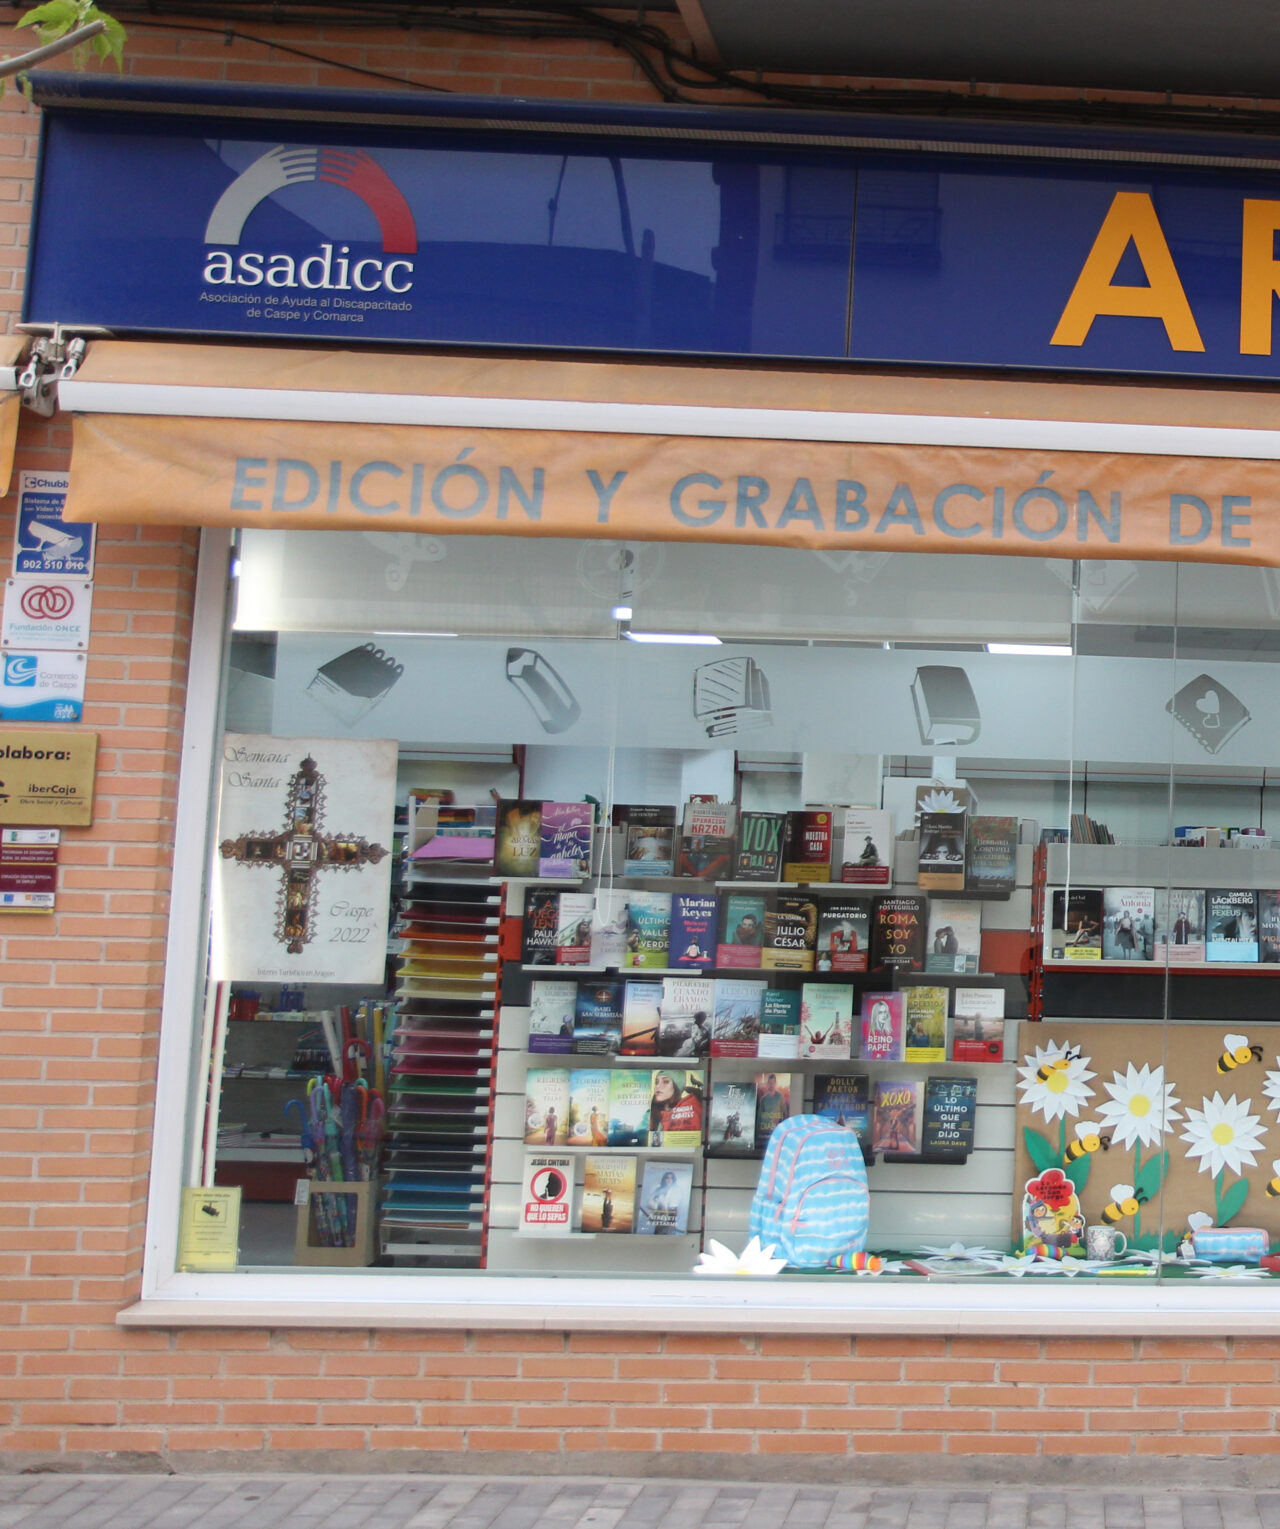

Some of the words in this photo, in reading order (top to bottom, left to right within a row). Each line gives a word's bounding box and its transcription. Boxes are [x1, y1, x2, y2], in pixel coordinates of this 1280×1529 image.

[203, 244, 414, 293] asadicc
[200, 292, 261, 304] Asociación
[264, 295, 278, 305] de
[281, 295, 317, 309] Ayuda
[320, 297, 330, 307] al
[334, 298, 412, 311] Discapacitado
[247, 308, 261, 318] de
[264, 309, 301, 321] Caspe
[303, 312, 310, 322] y
[313, 311, 364, 322] Comarca
[230, 446, 545, 524] EDICIÓN
[586, 469, 629, 524] Y
[670, 469, 1121, 545] GRABACIÓN
[1169, 493, 1252, 548] DE
[23, 560, 41, 569] 902
[45, 561, 63, 569] 510
[9, 623, 53, 631] Fundación
[40, 671, 78, 680] Comercio
[52, 681, 77, 689] Caspe
[223, 746, 291, 764] Semana
[228, 772, 282, 788] Santa
[28, 783, 77, 796] iberCaja
[743, 817, 783, 852] VOX
[809, 842, 824, 851] CASA
[680, 898, 715, 908] Marian
[1120, 899, 1152, 908] Antonia
[329, 901, 374, 921] Caspe
[682, 908, 712, 919] Keyes
[880, 914, 918, 925] ROMA
[329, 927, 370, 943] 2022
[642, 929, 669, 937] VALLE
[777, 926, 805, 935] JULIO
[886, 929, 911, 940] SOY
[774, 936, 806, 948] CÉSAR
[889, 944, 907, 955] YO
[868, 1035, 893, 1043] REINO
[867, 1044, 891, 1052] PAPEL
[881, 1090, 911, 1107] XOXO
[934, 1104, 967, 1112] ÚLTIMO
